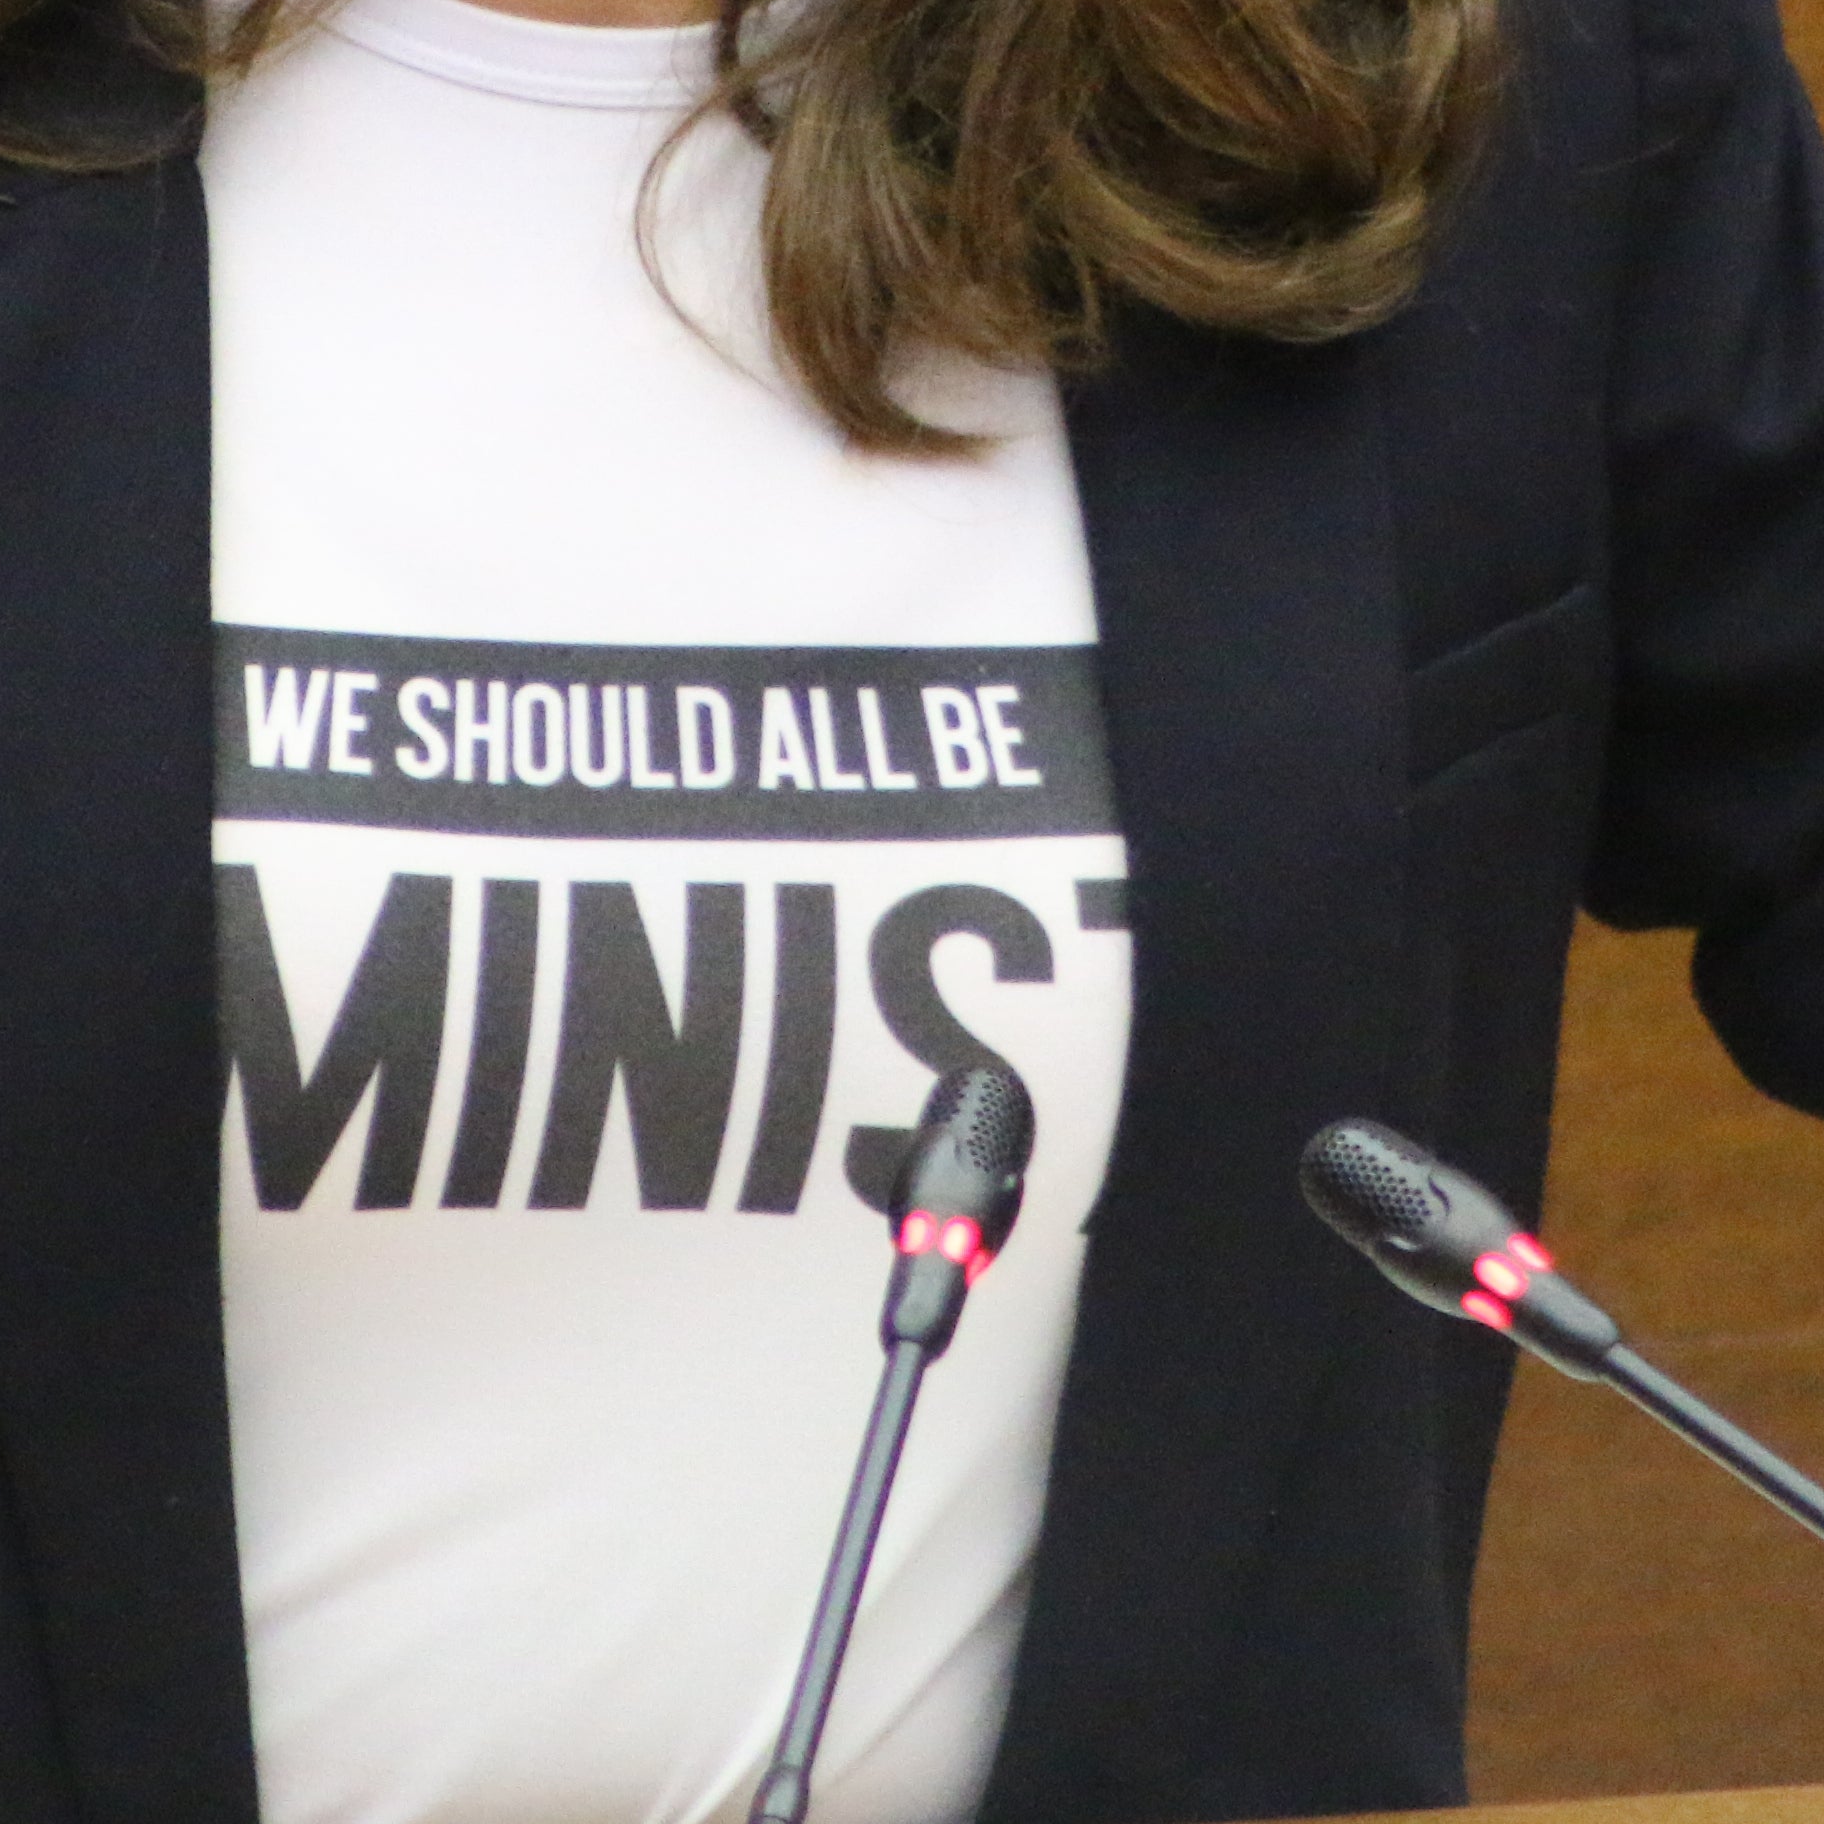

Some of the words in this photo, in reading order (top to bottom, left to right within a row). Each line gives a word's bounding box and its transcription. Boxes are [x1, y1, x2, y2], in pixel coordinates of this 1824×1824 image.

[242, 662, 382, 777] WE
[394, 676, 733, 792] SHOULD
[757, 685, 918, 792] ALL
[920, 683, 1044, 790] BE
